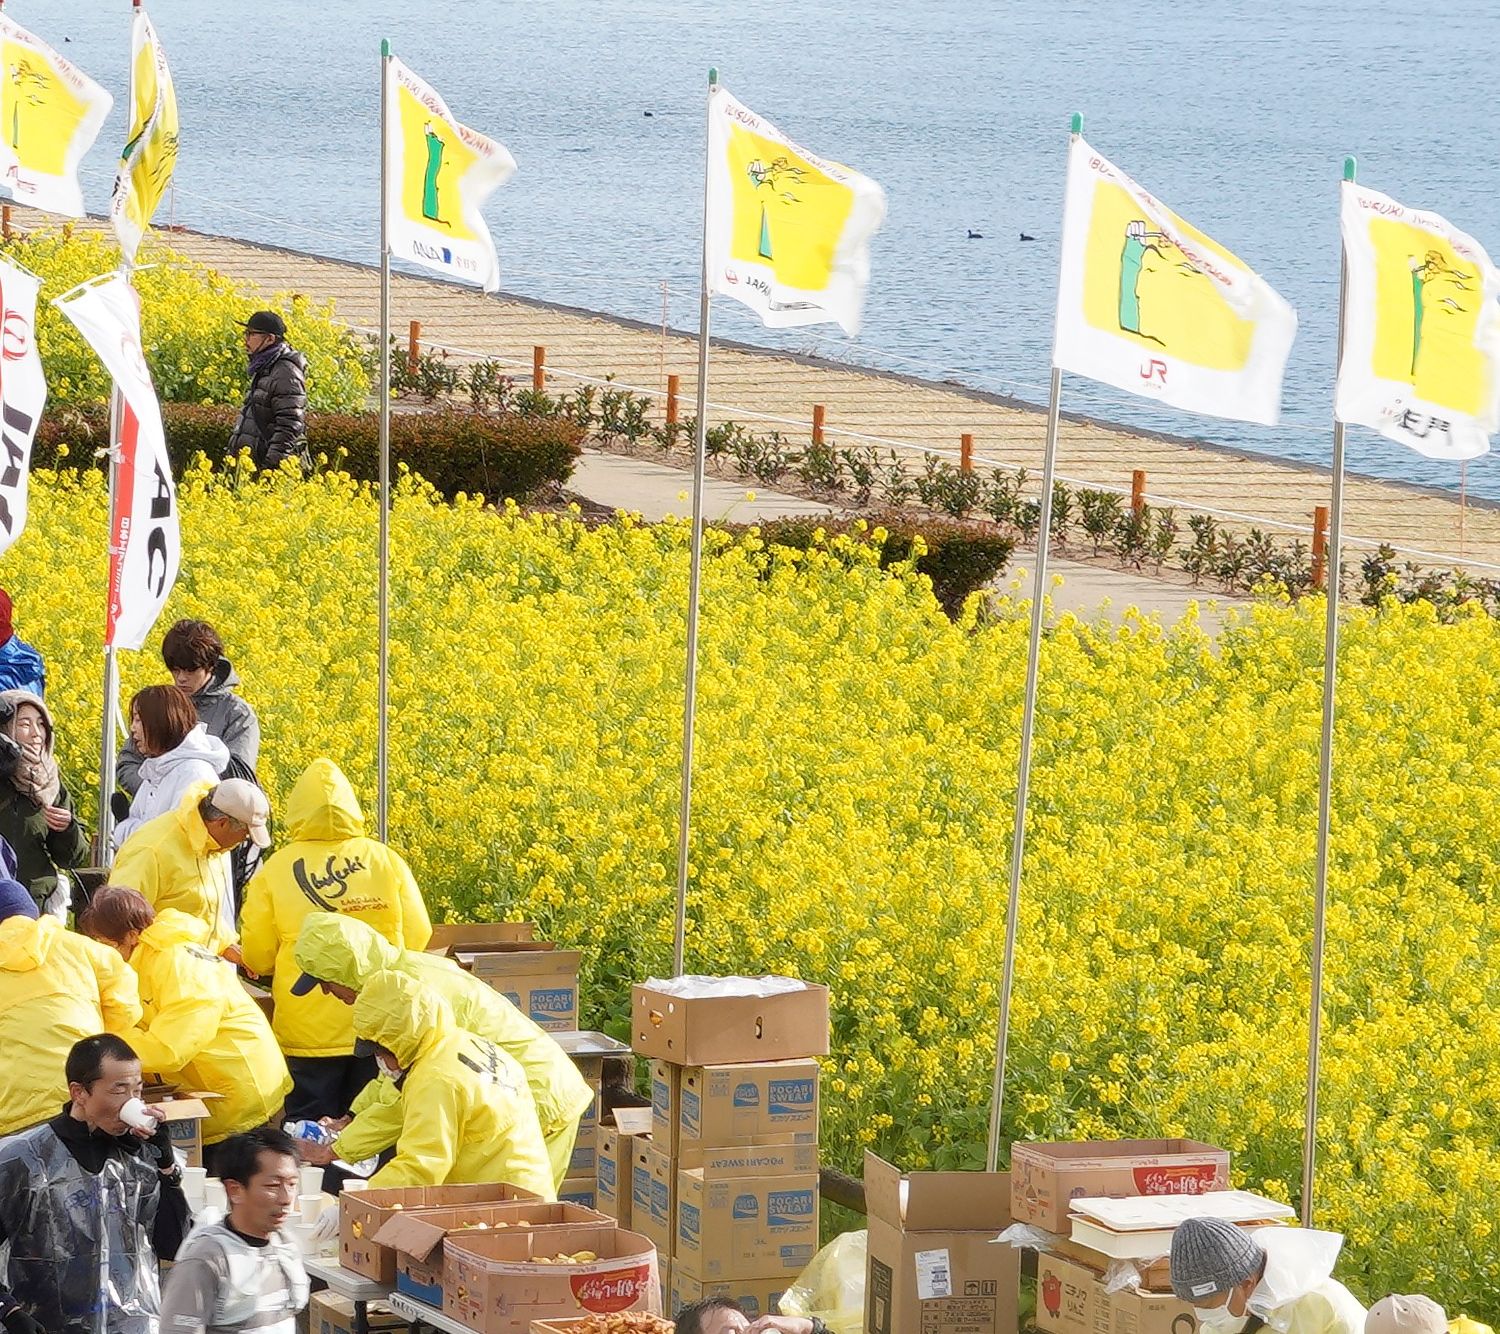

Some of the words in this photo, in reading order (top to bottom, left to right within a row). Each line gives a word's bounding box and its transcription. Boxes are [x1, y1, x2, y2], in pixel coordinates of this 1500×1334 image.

[1141, 358, 1168, 384] JR
[531, 994, 573, 1004] POCARI
[530, 1001, 569, 1012] SWEAT
[770, 1082, 814, 1094] POCARI
[770, 1091, 809, 1104] SWEAT
[710, 1158, 745, 1168] SWEAT
[746, 1156, 784, 1167] POCARI
[769, 1196, 813, 1208] POCARI
[768, 1204, 807, 1216] SWEAT
